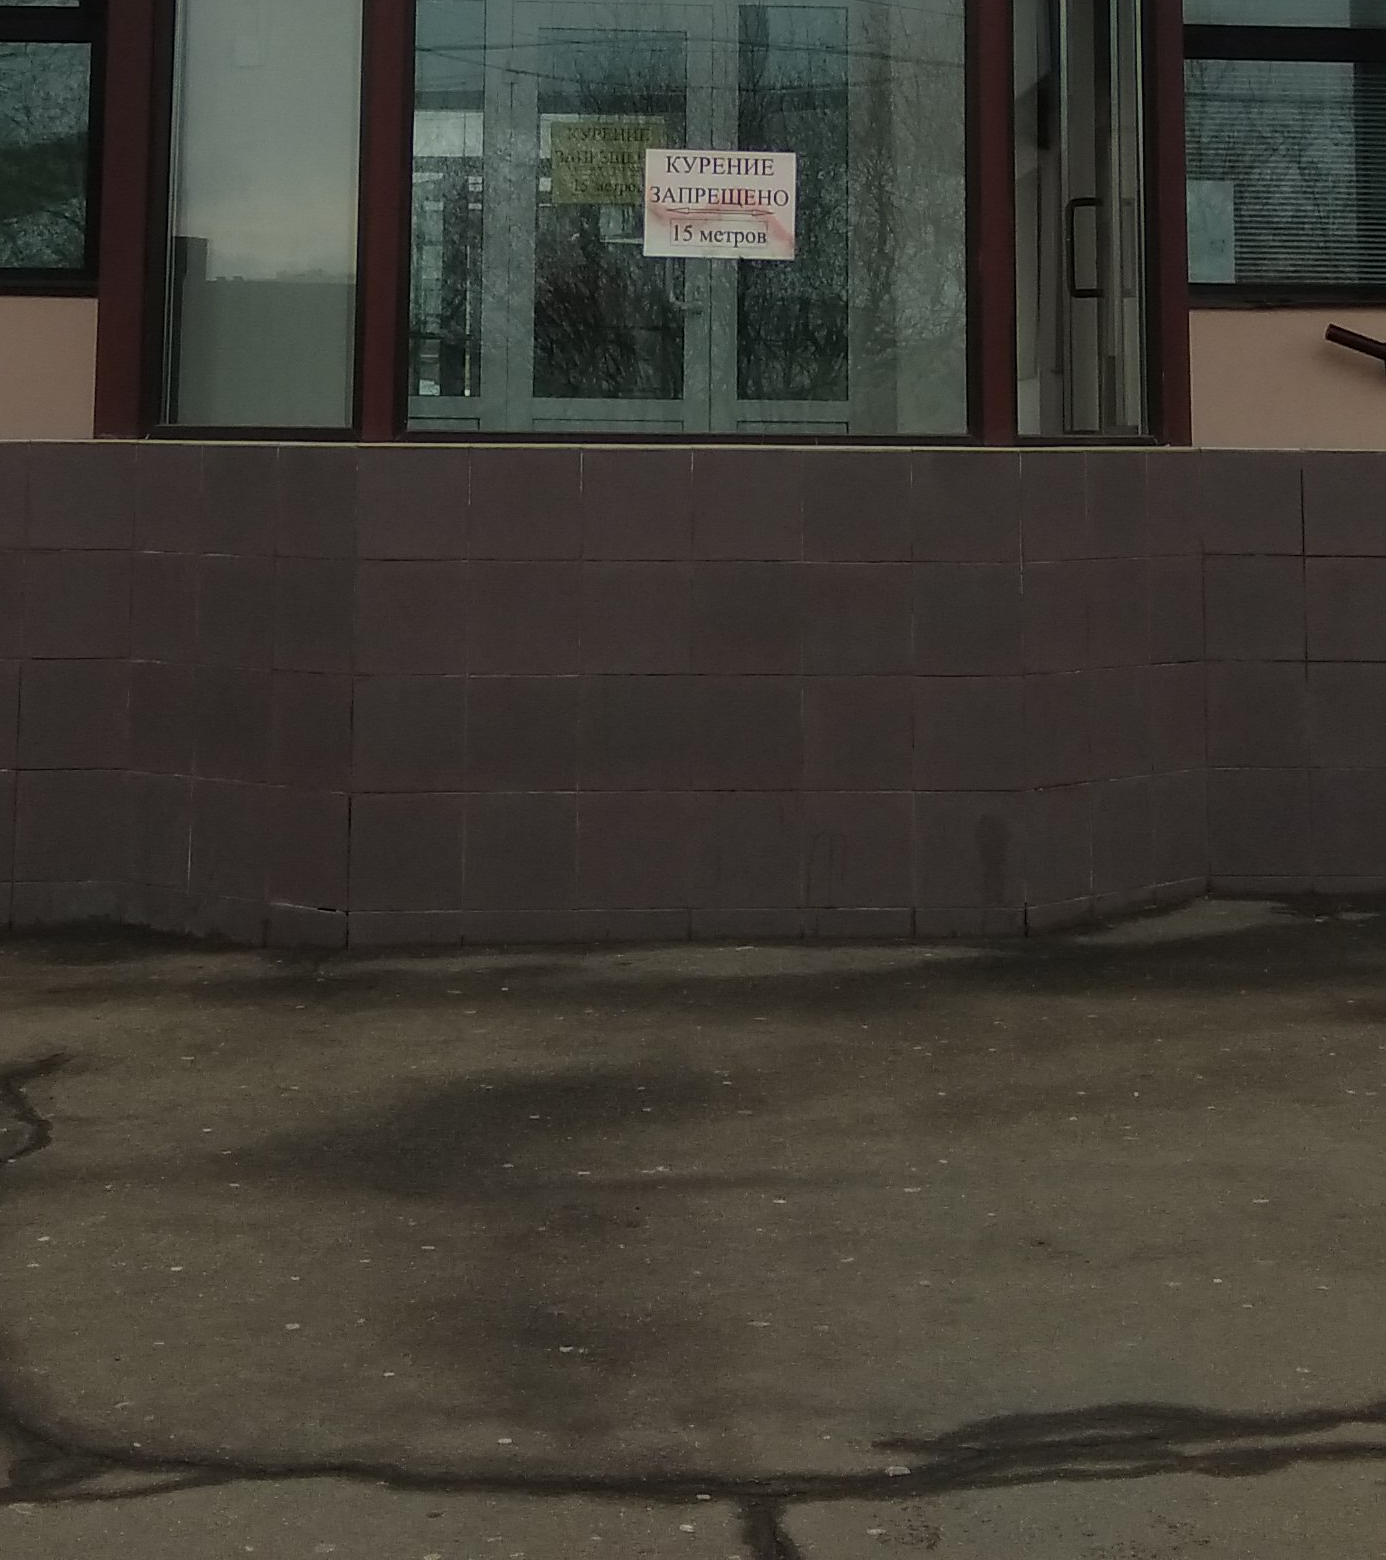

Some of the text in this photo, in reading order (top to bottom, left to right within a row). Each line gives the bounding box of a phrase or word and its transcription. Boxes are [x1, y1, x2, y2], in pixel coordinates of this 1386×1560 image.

[666, 155, 775, 177] КУРЕНИЕ
[649, 186, 790, 208] ЗАПРЕЩЕНО
[672, 224, 767, 249] 15 метров
